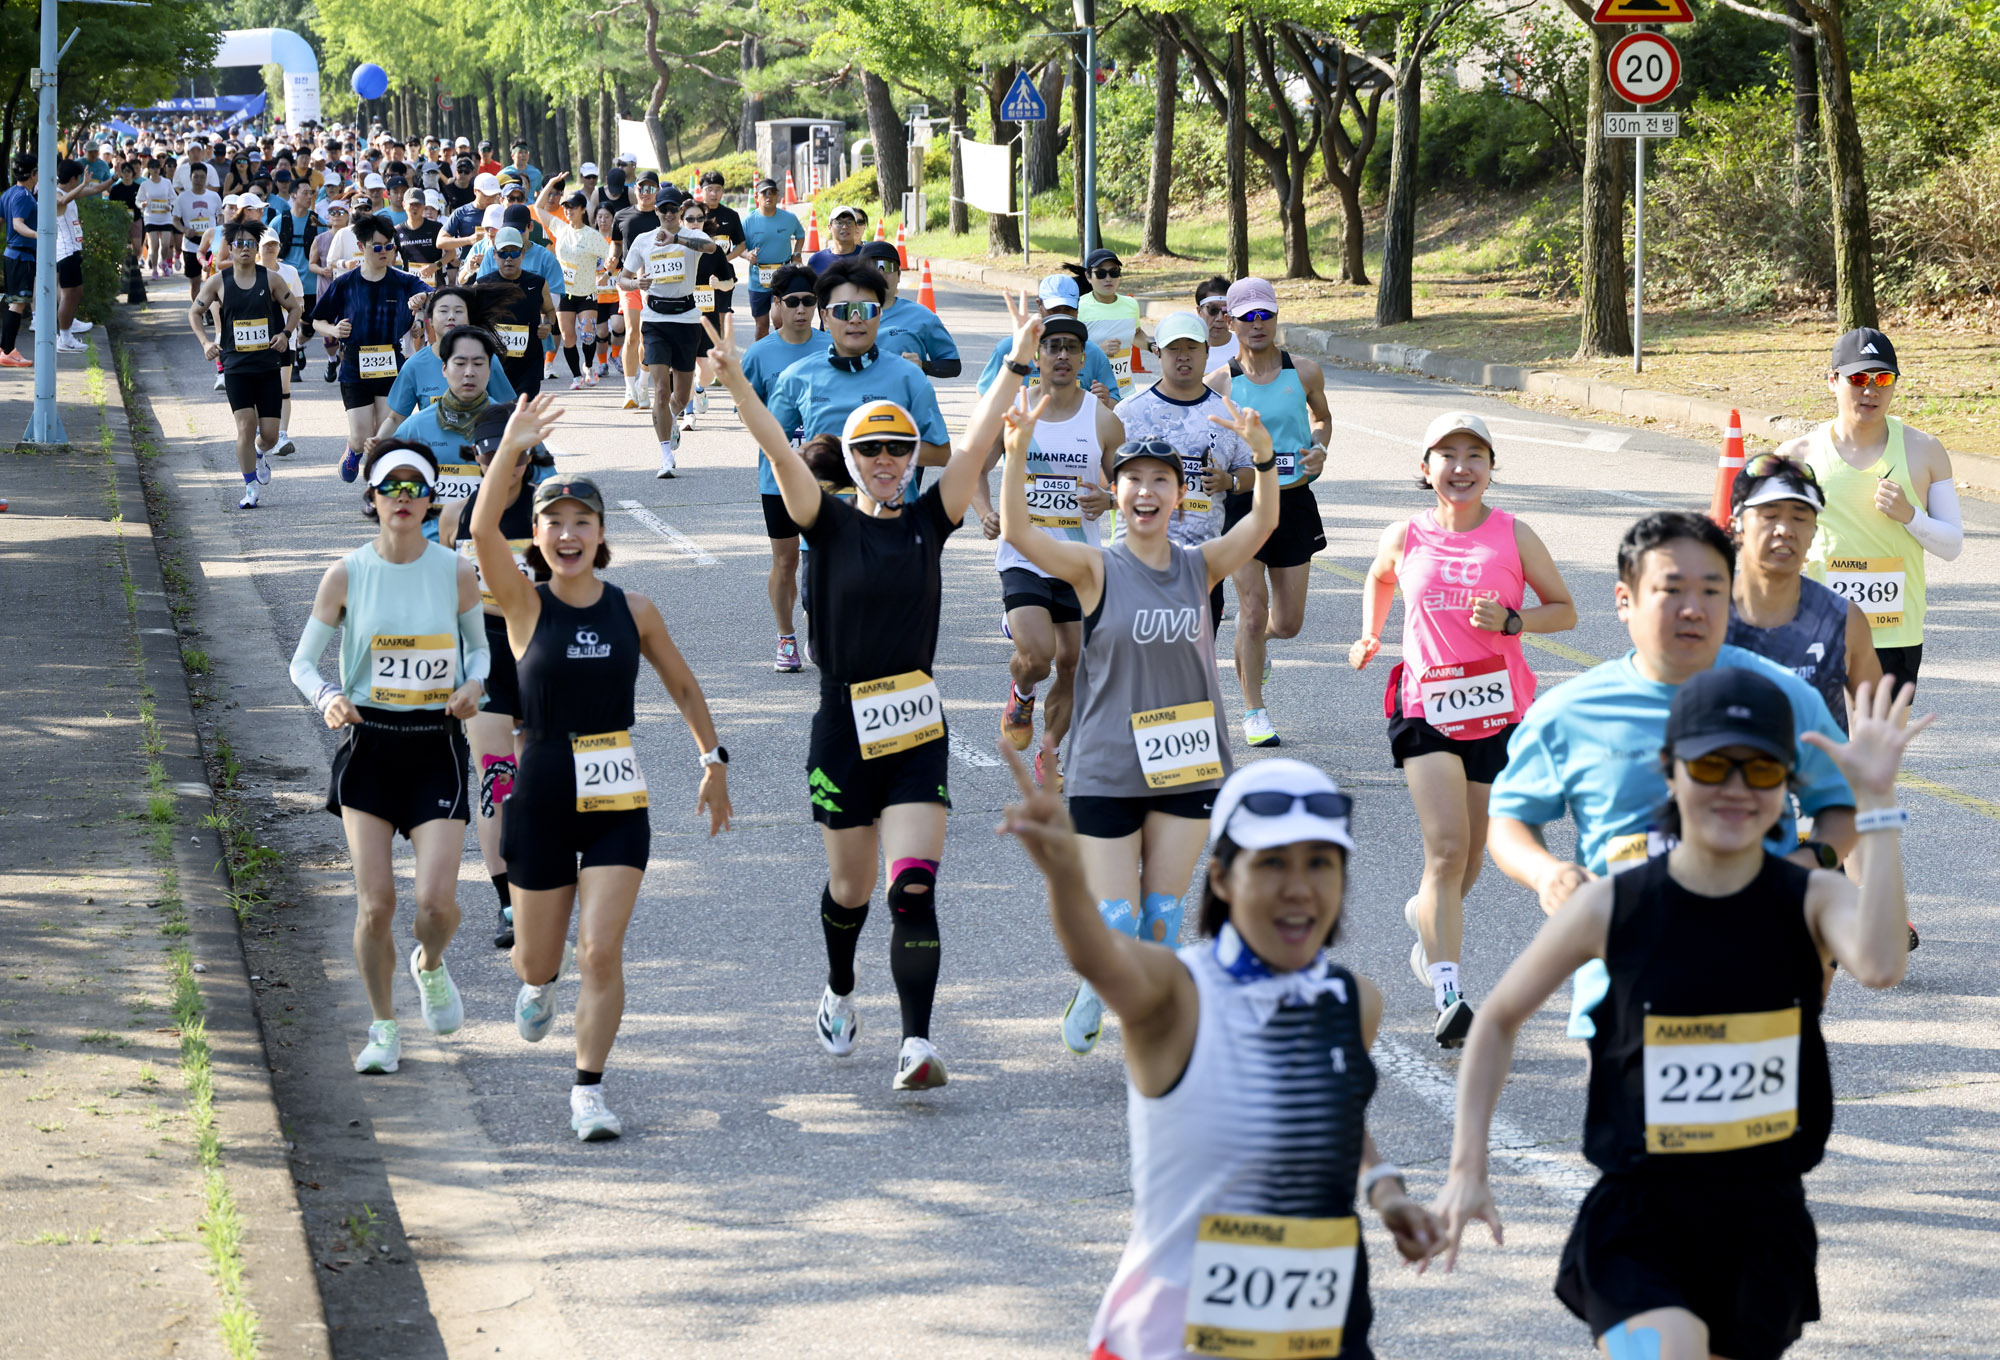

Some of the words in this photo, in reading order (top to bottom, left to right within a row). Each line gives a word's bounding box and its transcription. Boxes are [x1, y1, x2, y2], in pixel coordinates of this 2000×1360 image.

[1626, 54, 1663, 83] 20
[1609, 118, 1640, 133] 30m
[653, 261, 683, 274] 2139
[694, 294, 713, 304] 335
[236, 329, 266, 341] 2113
[499, 335, 527, 347] 340
[362, 355, 393, 368] 2324
[1026, 451, 1088, 463] UMANRACE
[1182, 461, 1203, 471] 042
[1043, 480, 1070, 490] 0450
[1026, 491, 1079, 510] 2268
[1831, 560, 1868, 570] 시사저널
[378, 656, 448, 681] 2102
[1430, 682, 1505, 713] 7038
[863, 694, 933, 732] 2090
[1145, 729, 1210, 761] 2099
[1659, 1056, 1786, 1103] 2228
[1204, 1262, 1339, 1311] 2073
